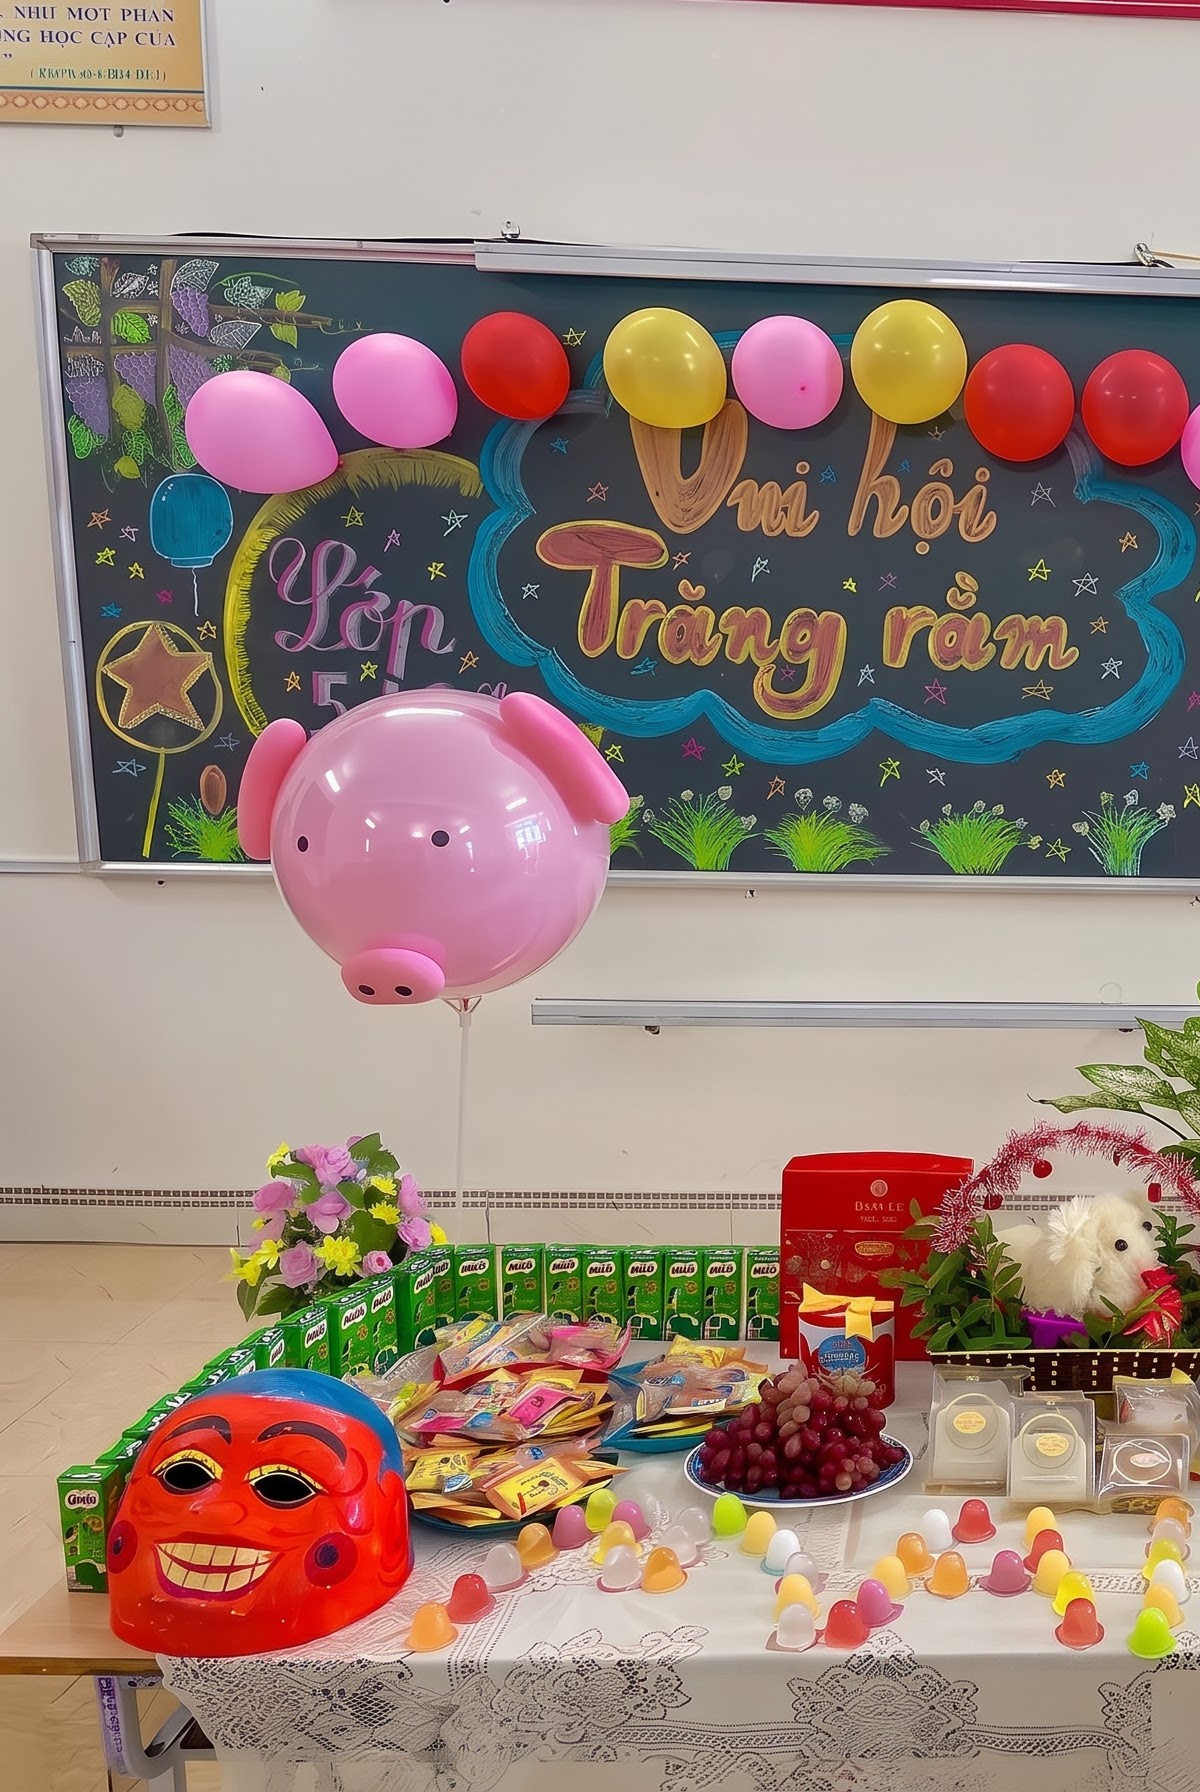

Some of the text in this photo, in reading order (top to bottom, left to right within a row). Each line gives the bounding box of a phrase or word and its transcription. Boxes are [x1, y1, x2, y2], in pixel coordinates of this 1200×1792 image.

[40, 29, 83, 48] HỌC
[536, 519, 1079, 721] Trăng rằm
